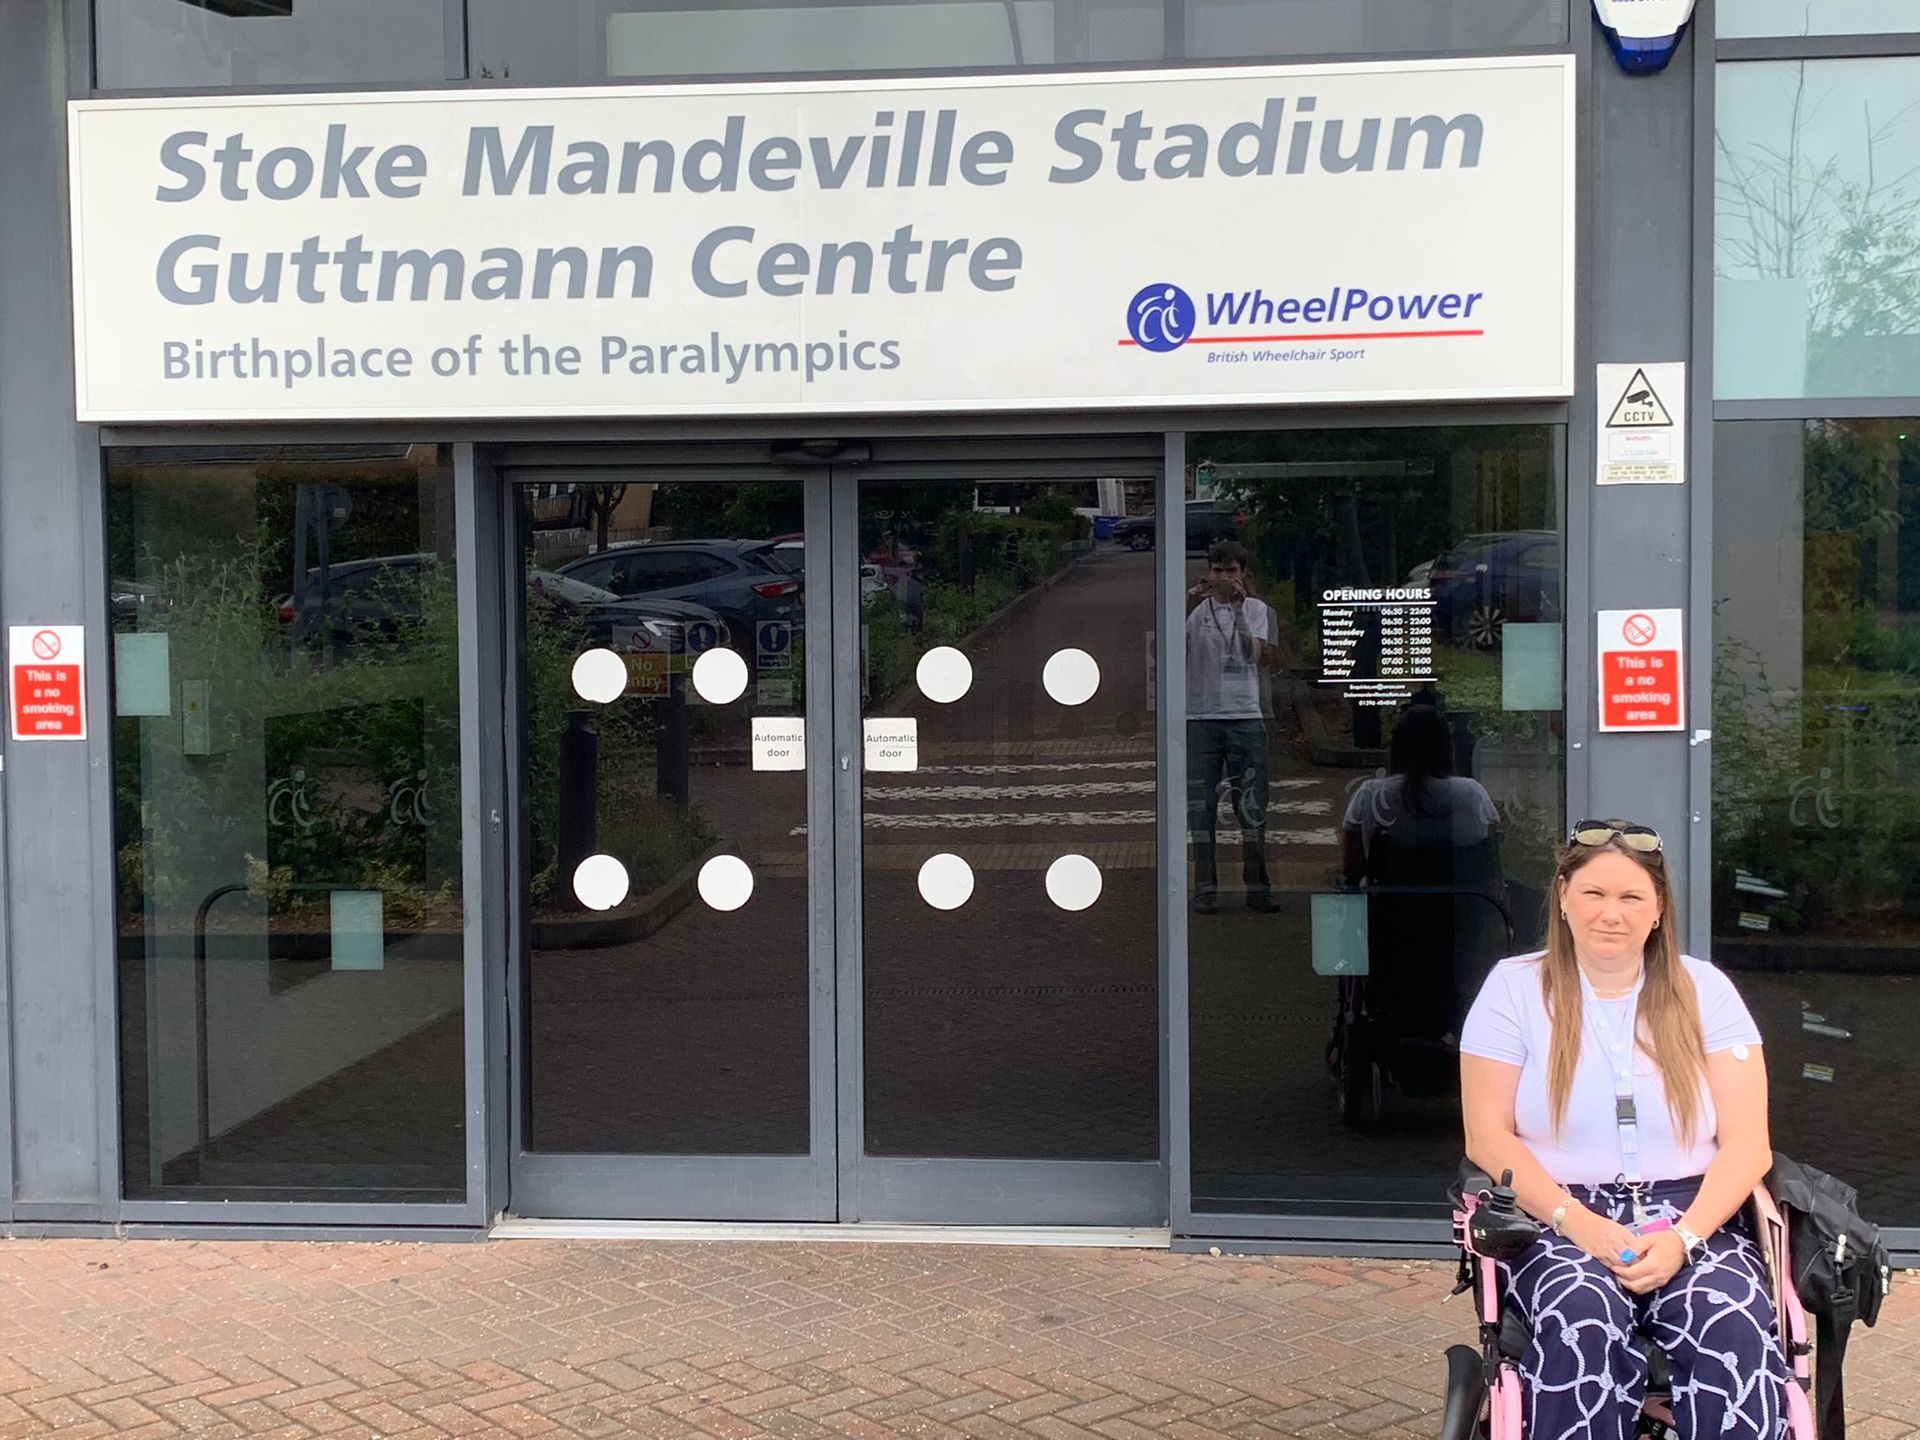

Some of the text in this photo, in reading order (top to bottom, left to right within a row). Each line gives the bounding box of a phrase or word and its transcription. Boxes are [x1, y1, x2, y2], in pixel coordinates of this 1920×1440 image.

[156, 97, 1483, 202] Stoke Mandeville Stadium
[157, 224, 1022, 305] Guttmann Centre
[1207, 287, 1482, 325] WheelPower
[164, 330, 900, 388] Birthplace of the Paralympics
[1208, 348, 1365, 363] British Wheelchair Sport
[1624, 411, 1654, 422] CCTV
[1323, 588, 1431, 600] OPENING HOURS
[1323, 609, 1352, 618] Monday
[1323, 619, 1353, 628] Tuesday
[1323, 629, 1364, 637] Wednesday
[1323, 639, 1356, 647] Thursday
[1323, 649, 1346, 657] Friday
[631, 658, 652, 672] No
[1323, 658, 1355, 667] Saturday
[1616, 656, 1663, 669] This is
[26, 669, 67, 682] This is
[1323, 668, 1350, 677] Sunday
[628, 674, 661, 691] ntry
[1624, 676, 1656, 686] a no
[34, 688, 60, 698] a no
[1611, 691, 1672, 706] smoking
[22, 702, 75, 717] smoking
[1625, 710, 1657, 721] area
[35, 720, 62, 730] area
[754, 733, 803, 742] Automatic
[866, 734, 915, 743] Automatic
[767, 749, 789, 757] door
[879, 750, 902, 758] door
